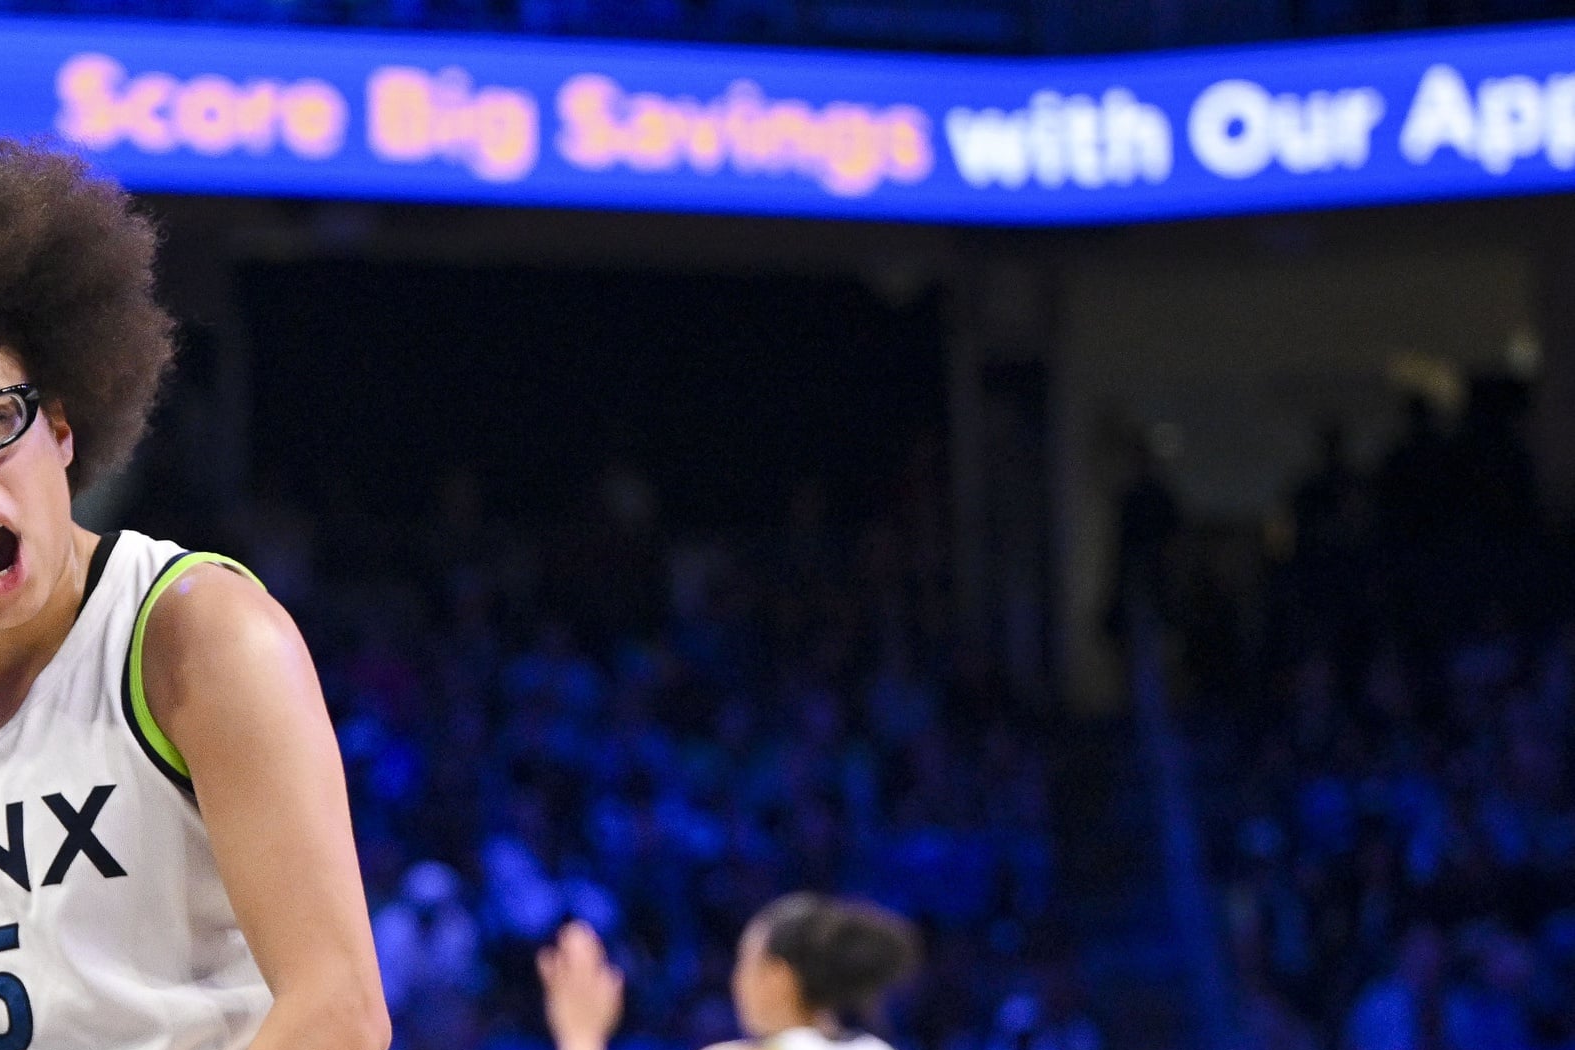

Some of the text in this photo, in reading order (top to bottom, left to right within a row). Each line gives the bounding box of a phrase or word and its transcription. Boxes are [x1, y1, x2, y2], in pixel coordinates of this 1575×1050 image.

[57, 53, 346, 157] Score
[367, 66, 539, 182] Big
[558, 73, 933, 196] Savings
[946, 87, 1173, 188] with
[1188, 79, 1384, 178] Our
